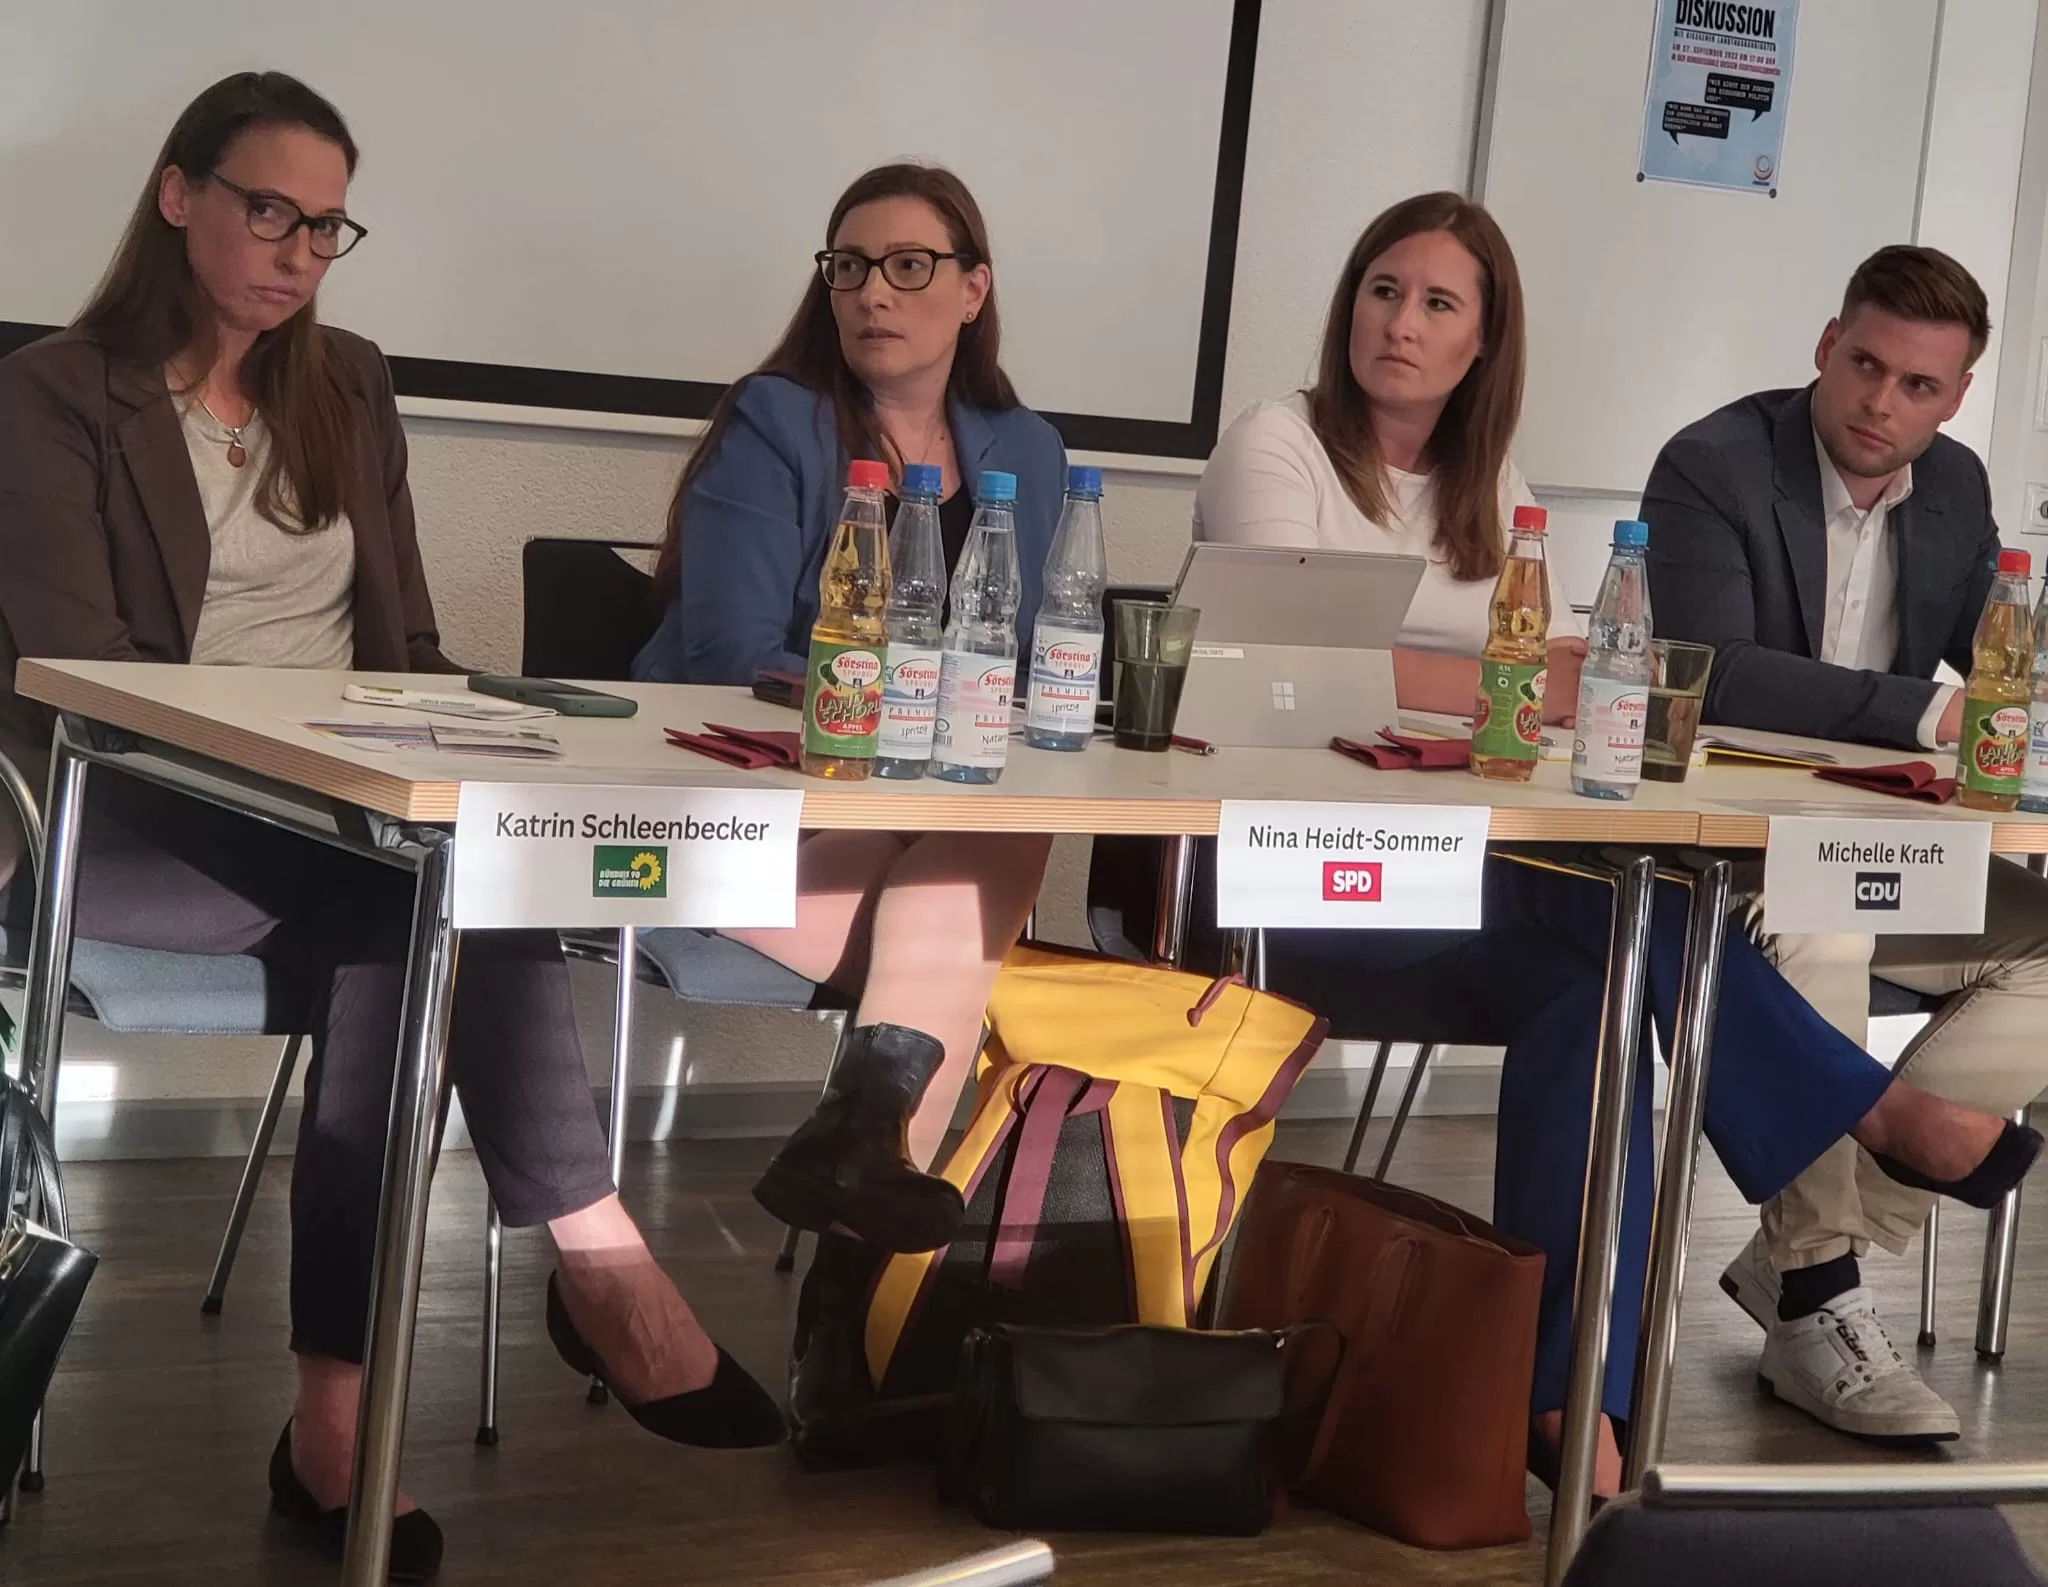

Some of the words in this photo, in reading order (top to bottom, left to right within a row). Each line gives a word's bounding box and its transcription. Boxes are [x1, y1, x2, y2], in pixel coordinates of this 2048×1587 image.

[1675, 0, 1775, 38] DISKUSSION
[836, 656, 878, 670] Förstina
[1049, 648, 1091, 662] Förstina
[496, 812, 575, 839] Katrin
[581, 813, 770, 841] Schleenbecker
[1248, 826, 1298, 850] Nina
[1305, 827, 1464, 852] Heidt-Sommer
[1818, 842, 1895, 864] Michelle
[1900, 844, 1945, 865] Kraft
[1332, 870, 1372, 894] SPD
[1856, 882, 1900, 902] CDU
